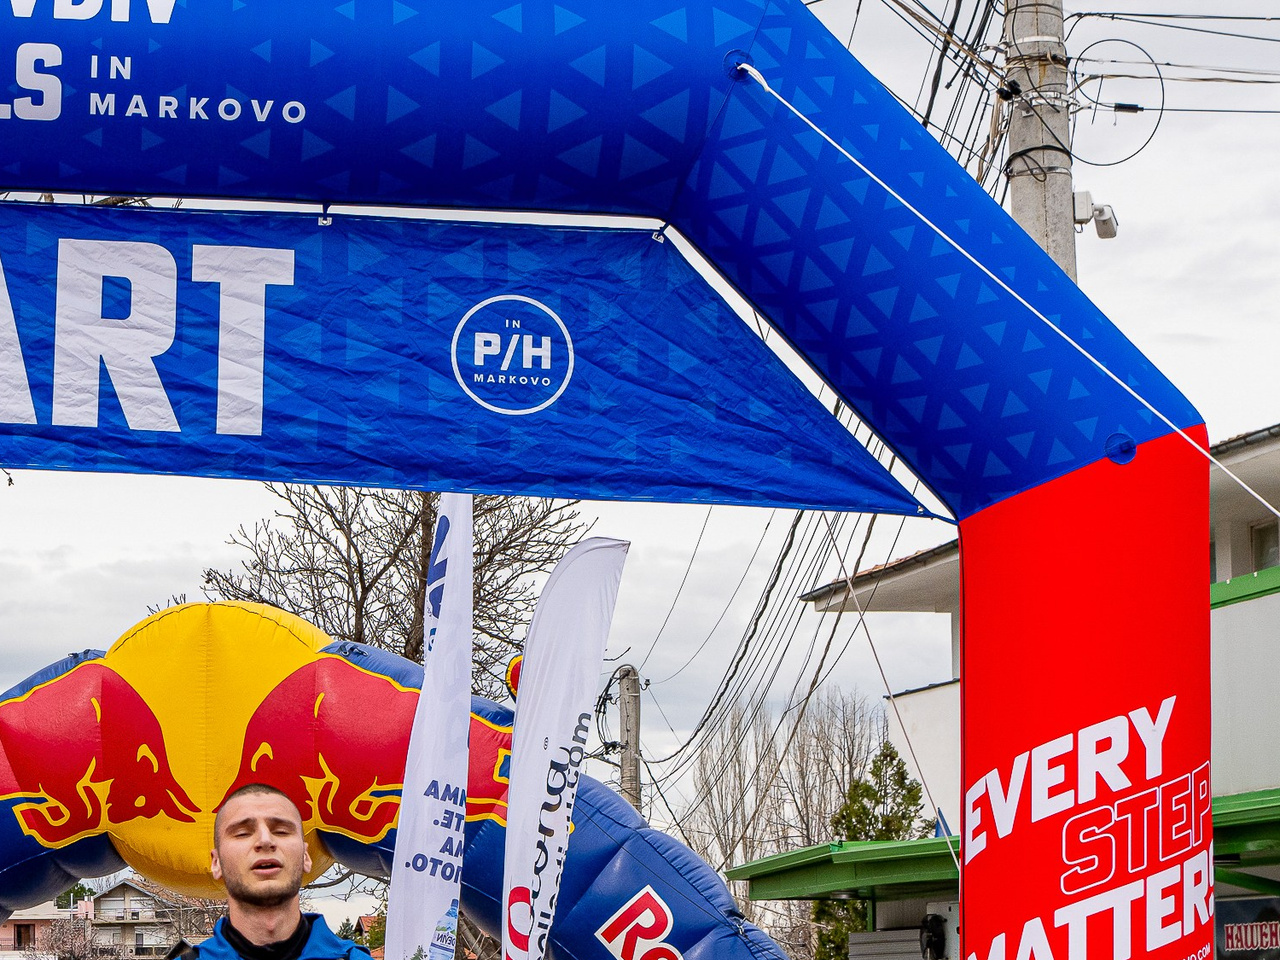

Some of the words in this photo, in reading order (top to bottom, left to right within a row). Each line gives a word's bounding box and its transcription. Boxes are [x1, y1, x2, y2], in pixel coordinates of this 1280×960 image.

[91, 55, 132, 80] IN
[90, 93, 307, 123] MARKOVO
[505, 319, 521, 329] IN
[474, 332, 551, 371] P/H
[474, 373, 551, 391] MARKOVO
[965, 695, 1176, 865] EVERY
[1061, 761, 1211, 895] STEP
[1224, 921, 1280, 951] НАШЕН
